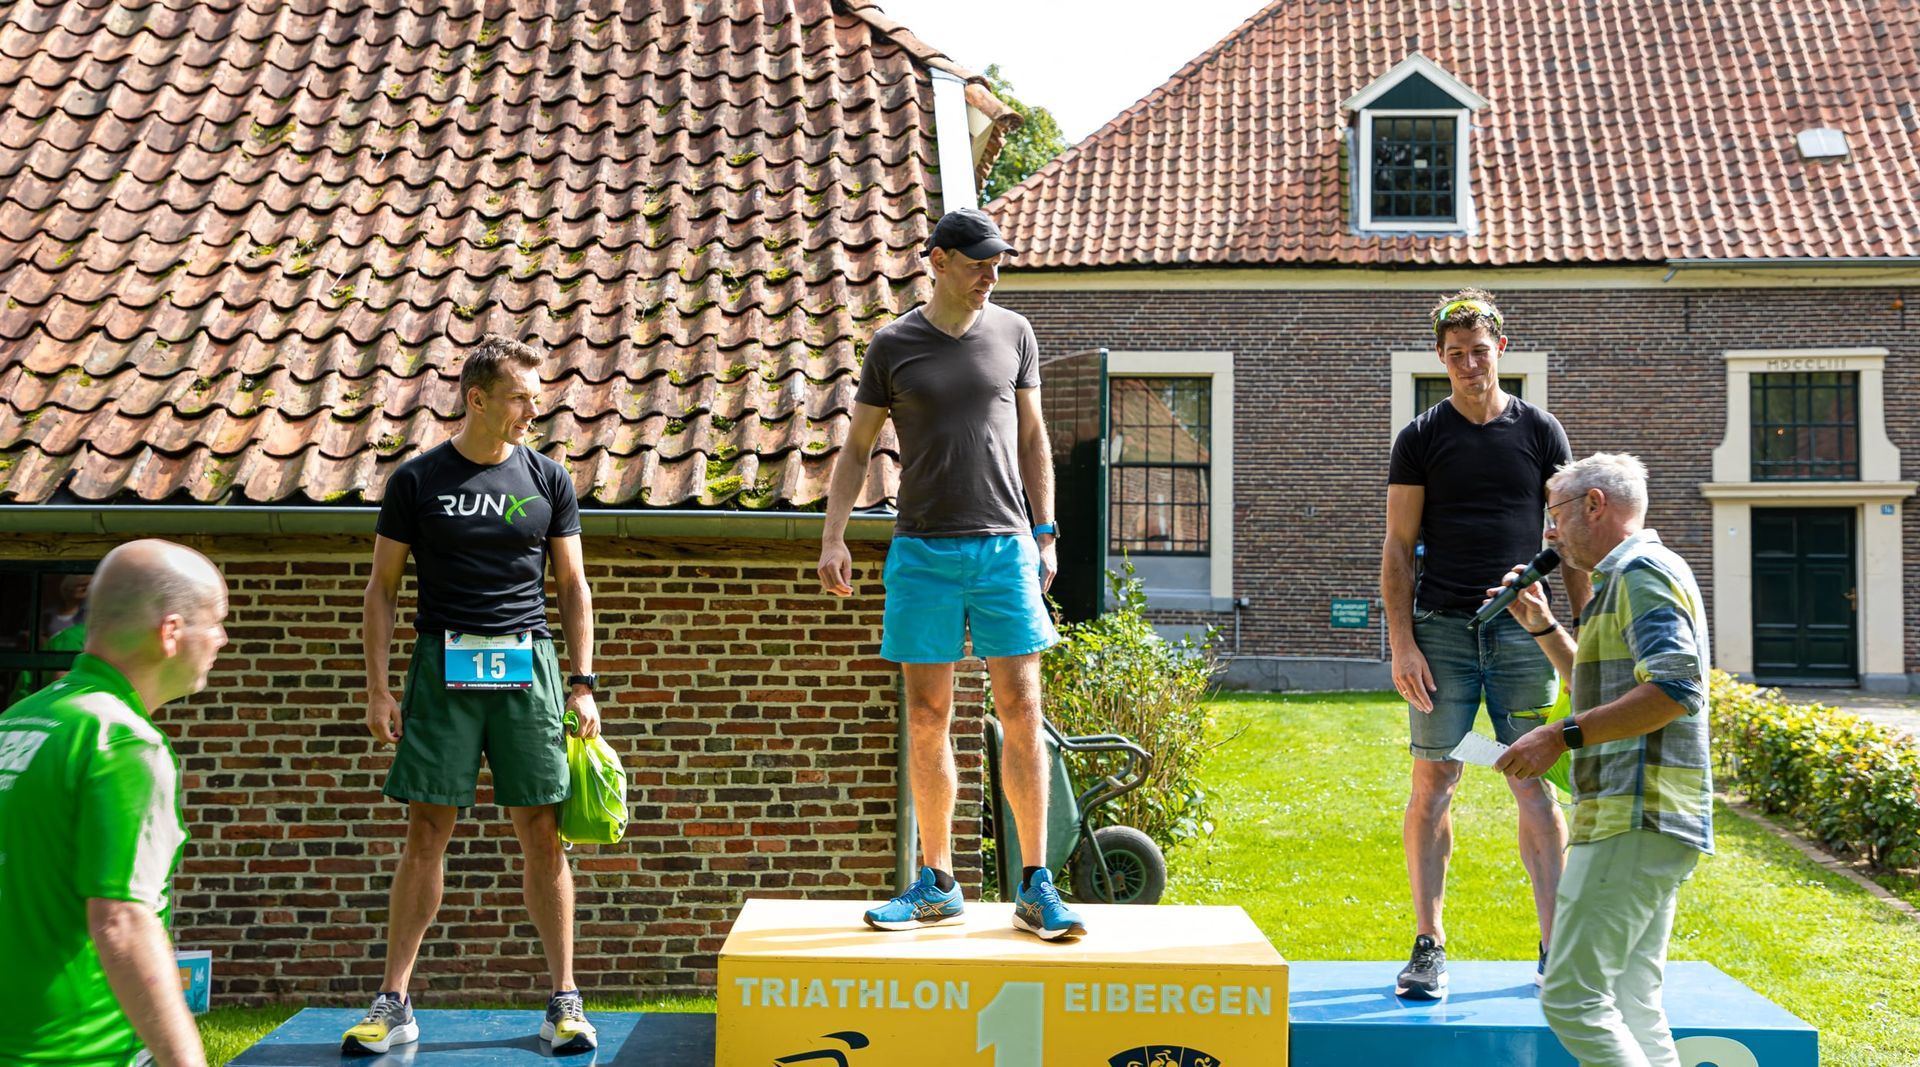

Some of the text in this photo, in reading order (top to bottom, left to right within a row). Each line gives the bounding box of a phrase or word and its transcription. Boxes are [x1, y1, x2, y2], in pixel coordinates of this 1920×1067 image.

[1766, 358, 1847, 370] MDCCLIII
[437, 493, 540, 524] RUNX
[472, 652, 506, 679] 15
[735, 977, 1272, 1016] TRIATHLON EIBERGEN
[977, 981, 1044, 1067] 1
